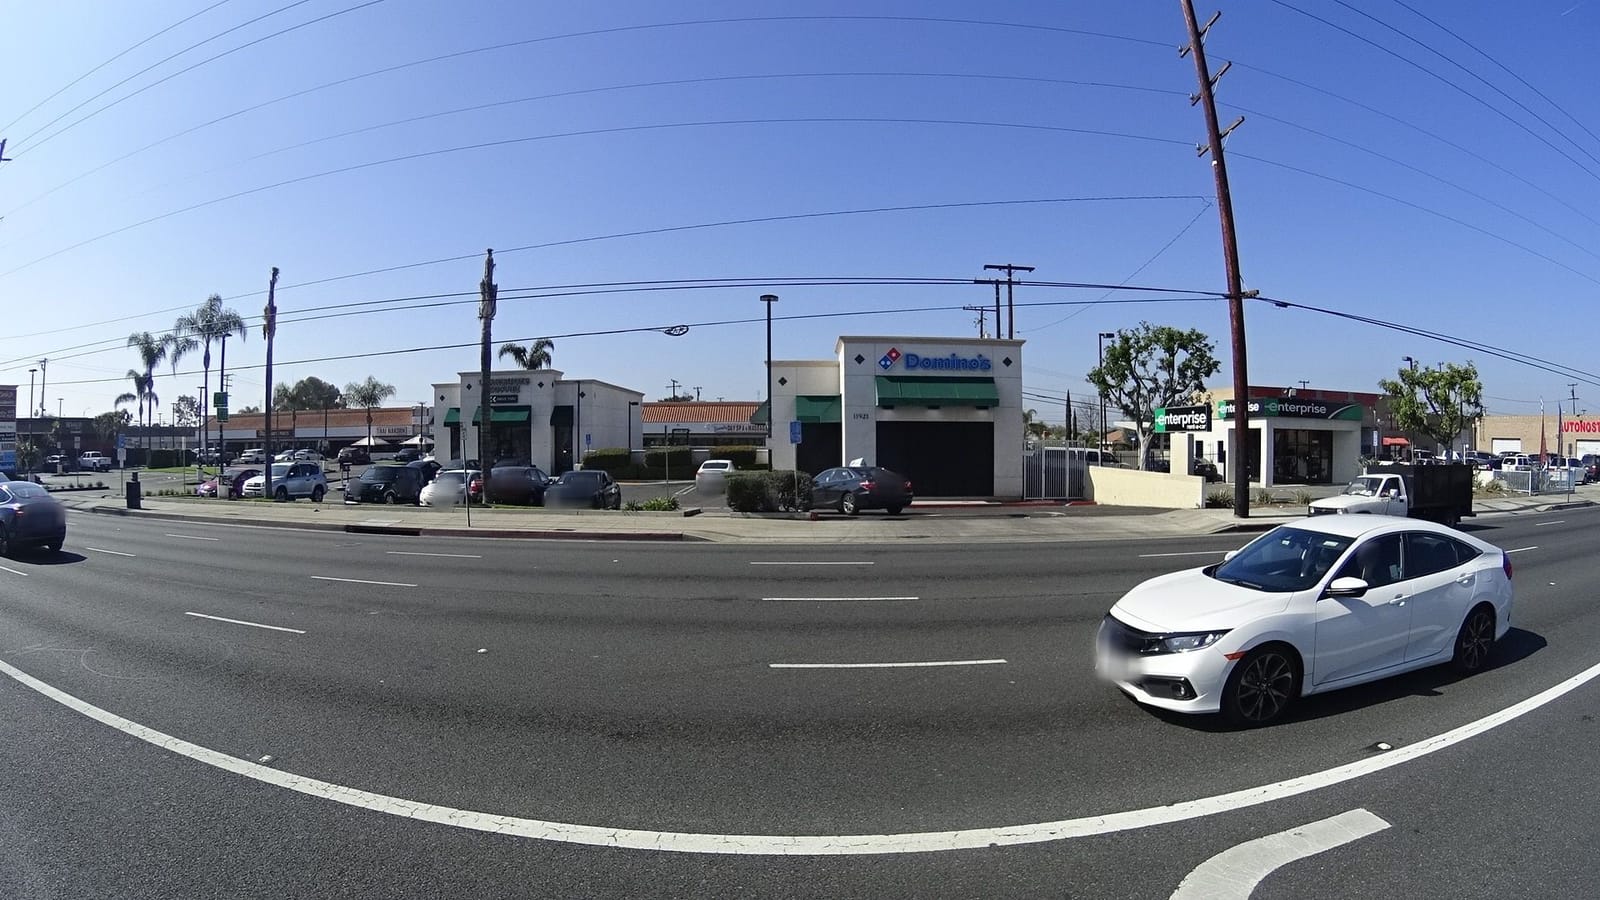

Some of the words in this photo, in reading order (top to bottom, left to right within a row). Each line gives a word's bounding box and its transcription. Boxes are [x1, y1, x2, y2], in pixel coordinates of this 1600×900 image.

[905, 353, 991, 371] Domino's
[1219, 401, 1259, 414] enteise
[1269, 402, 1327, 415] enterprise
[1157, 411, 1207, 428] enterprise
